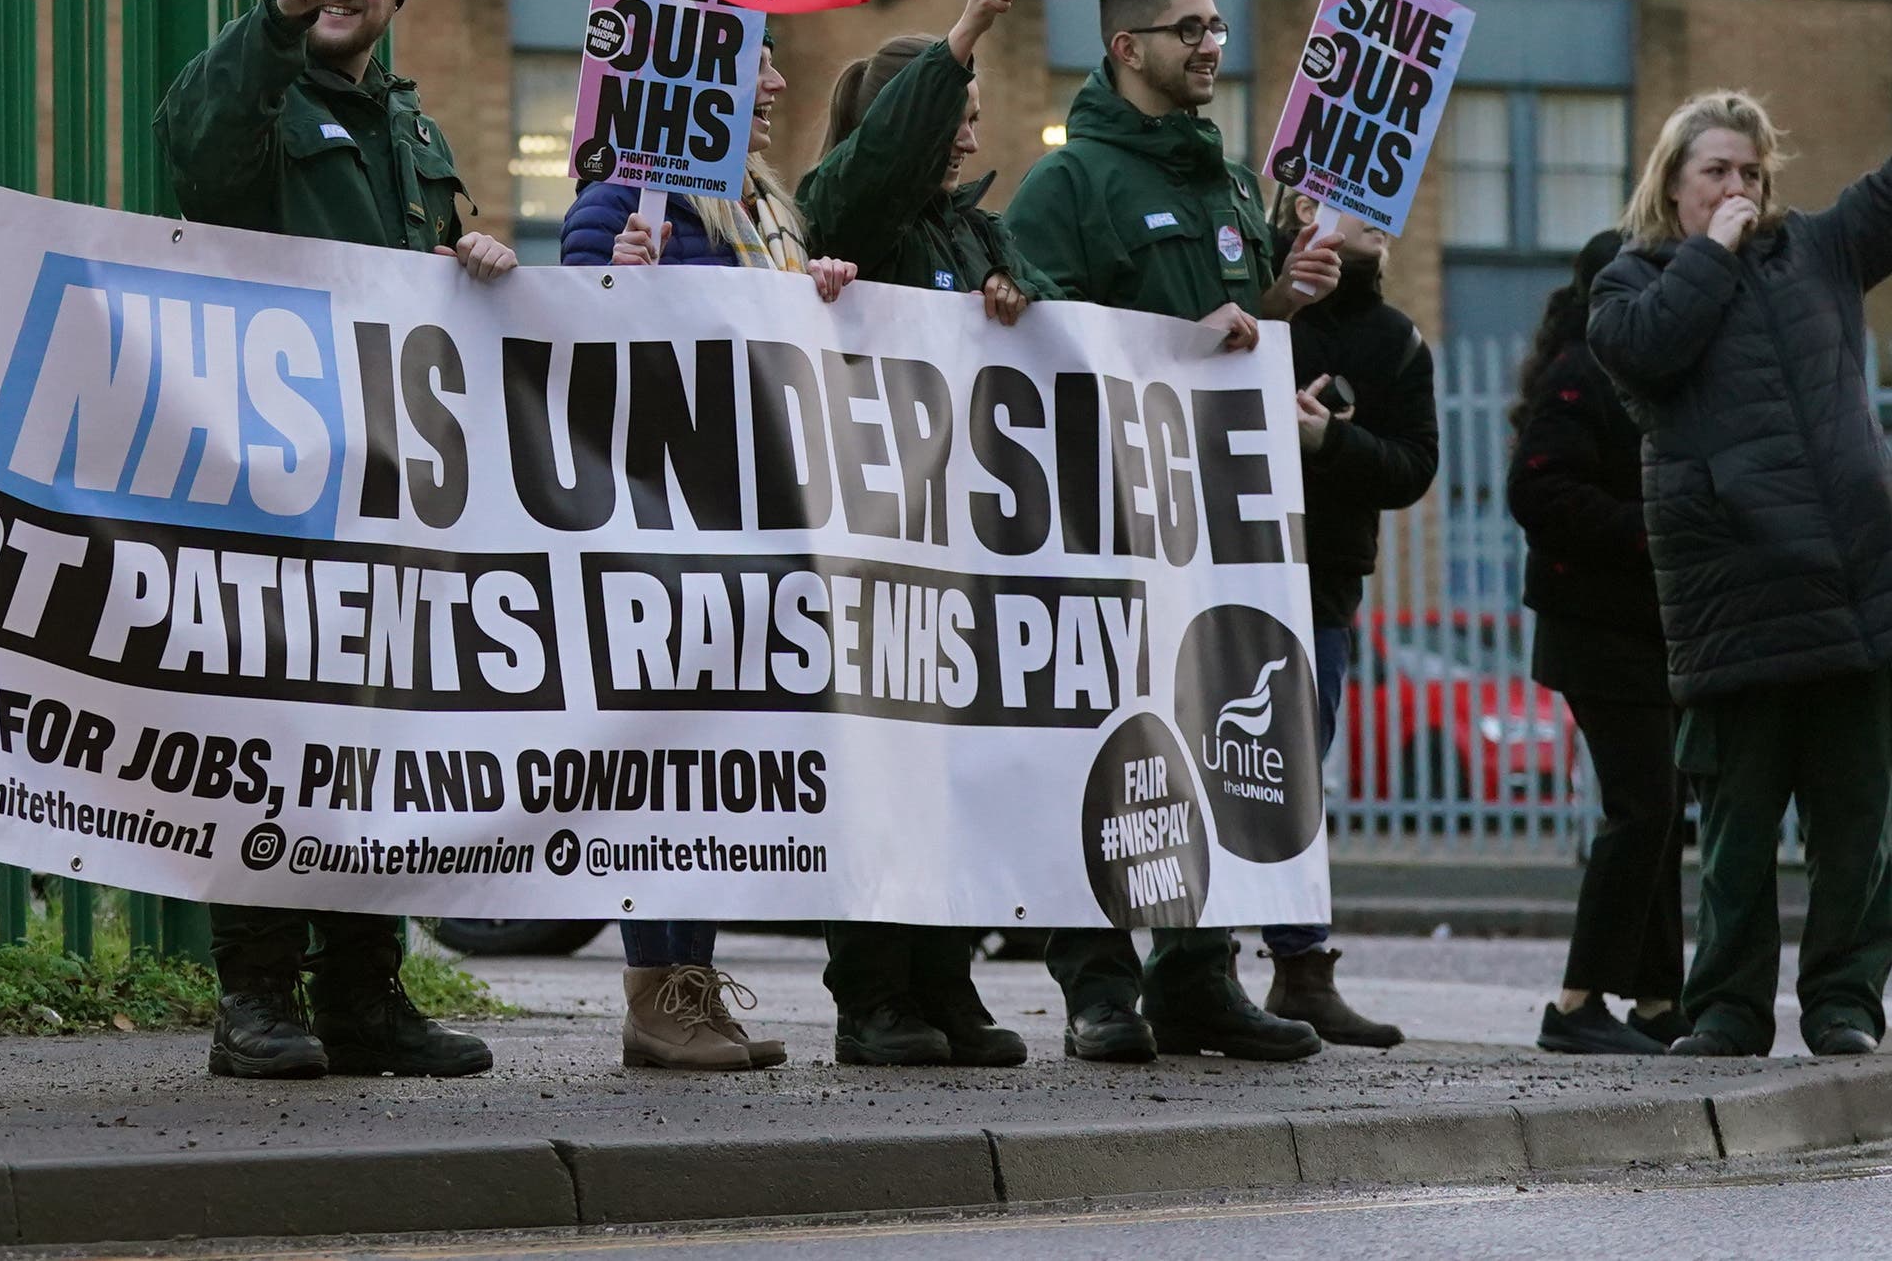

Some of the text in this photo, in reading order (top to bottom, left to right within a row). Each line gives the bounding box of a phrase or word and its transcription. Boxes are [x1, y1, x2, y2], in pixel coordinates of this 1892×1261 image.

[598, 18, 616, 31] FAIR
[1316, 31, 1433, 135] OUR
[593, 74, 735, 163] NHS
[619, 150, 690, 171] FIGHTING FOR
[1292, 92, 1412, 198] NHS
[617, 167, 727, 193] JOBS PAY CONDITIONS
[1304, 178, 1392, 226] JOBS PAY CONDITIONS
[1309, 165, 1347, 191] FIGHTING
[1348, 181, 1366, 198] FOR
[7, 283, 332, 517] NHS
[353, 320, 469, 529] IS
[502, 336, 953, 547] UNDER
[88, 538, 546, 694] PATIENTS
[600, 570, 863, 695] RAISE
[872, 581, 979, 709] NHS
[995, 594, 1143, 710] PAY
[117, 726, 285, 820] JOBS,
[298, 743, 382, 811] PAY
[394, 749, 505, 813] AND
[515, 748, 828, 814] CONDITIONS
[1123, 755, 1169, 806] FAIR
[1202, 734, 1285, 784] unite
[1224, 781, 1285, 805] theUNION
[288, 834, 535, 875] @unitetheunion
[586, 834, 828, 877] @unitetheunion
[1101, 801, 1190, 862] #NHSPAY
[1127, 856, 1187, 910] NOW!
